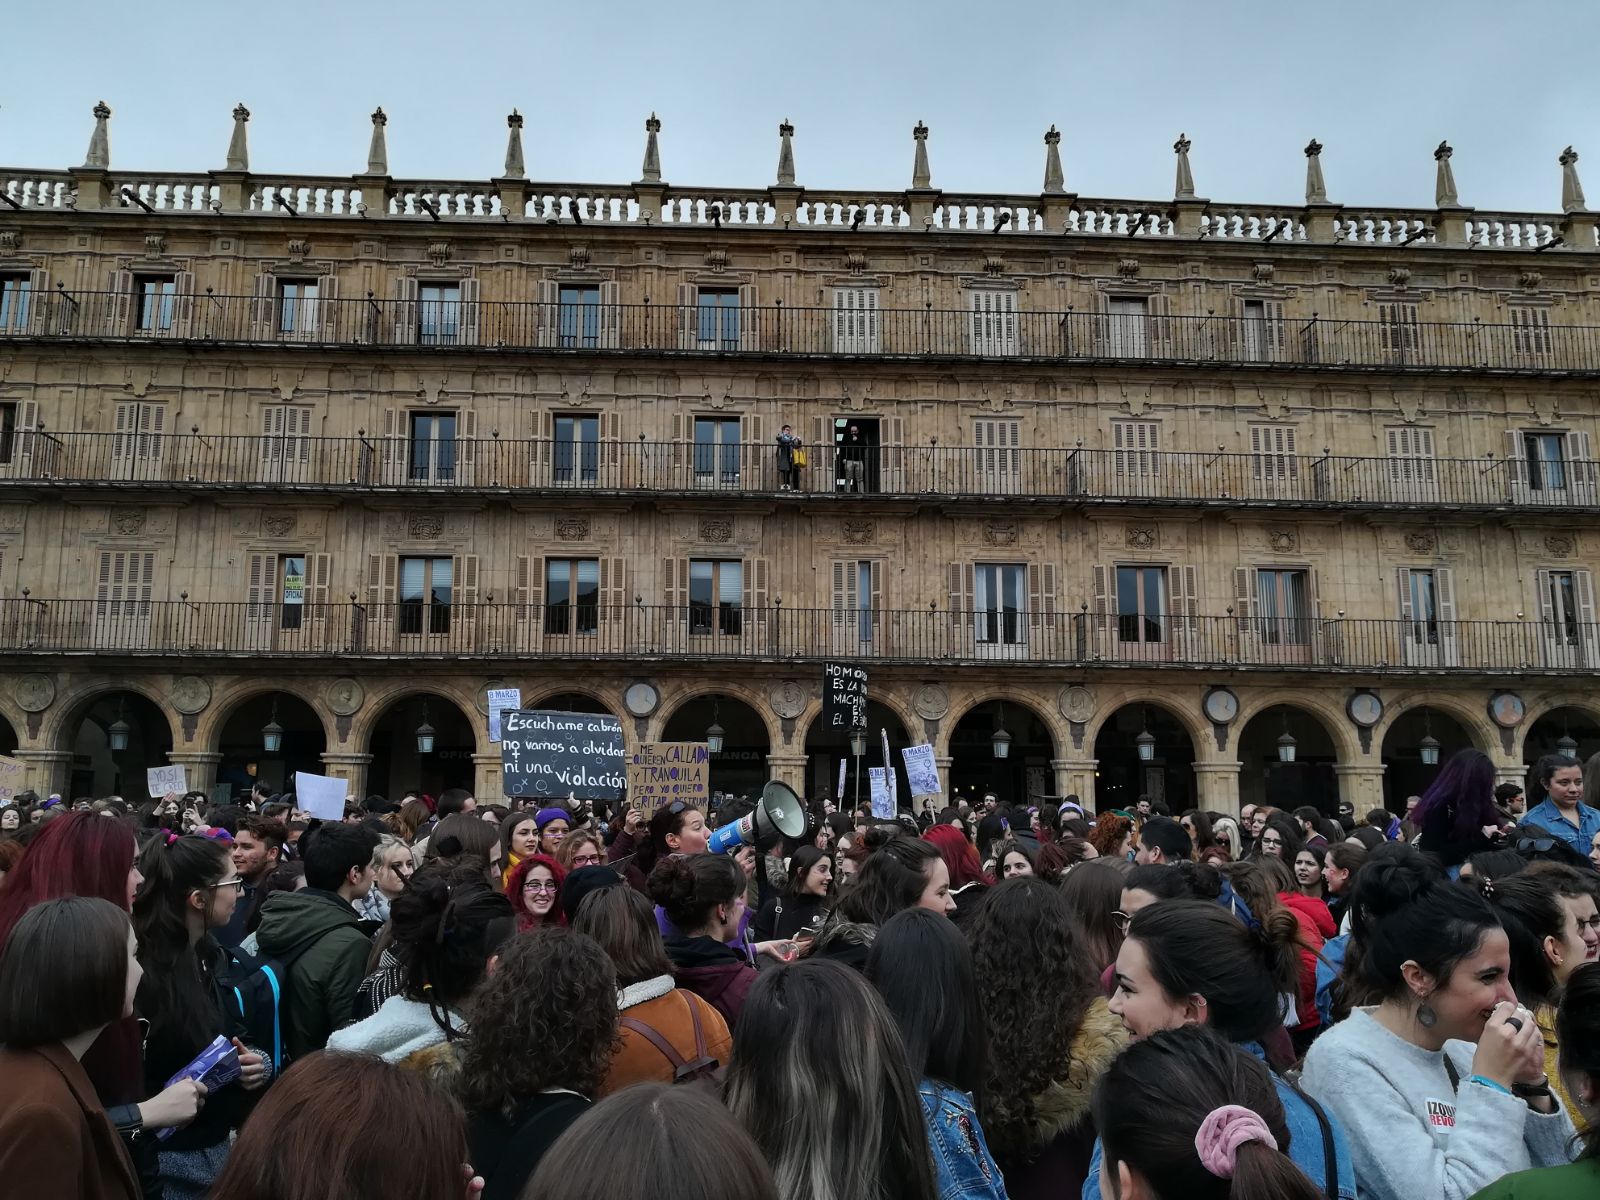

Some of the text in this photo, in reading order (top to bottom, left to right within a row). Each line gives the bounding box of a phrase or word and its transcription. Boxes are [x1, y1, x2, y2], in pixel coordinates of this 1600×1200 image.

[833, 678, 845, 689] ES
[847, 680, 858, 691] LA
[495, 690, 518, 699] MARZO
[507, 713, 622, 733] Escuchame cabrón
[832, 712, 845, 725] EL
[503, 739, 626, 757] no vamos a olvidar
[640, 745, 654, 755] ME
[908, 745, 930, 756] MARZO
[633, 746, 709, 766] QUIEREN CALLADA
[153, 769, 166, 782] YO
[504, 760, 628, 789] ni una violación
[633, 767, 701, 783] Y TRANQUILA
[150, 784, 161, 794] TE
[633, 784, 704, 795] PERO YO QUIERO
[632, 796, 667, 809] GRITAR
